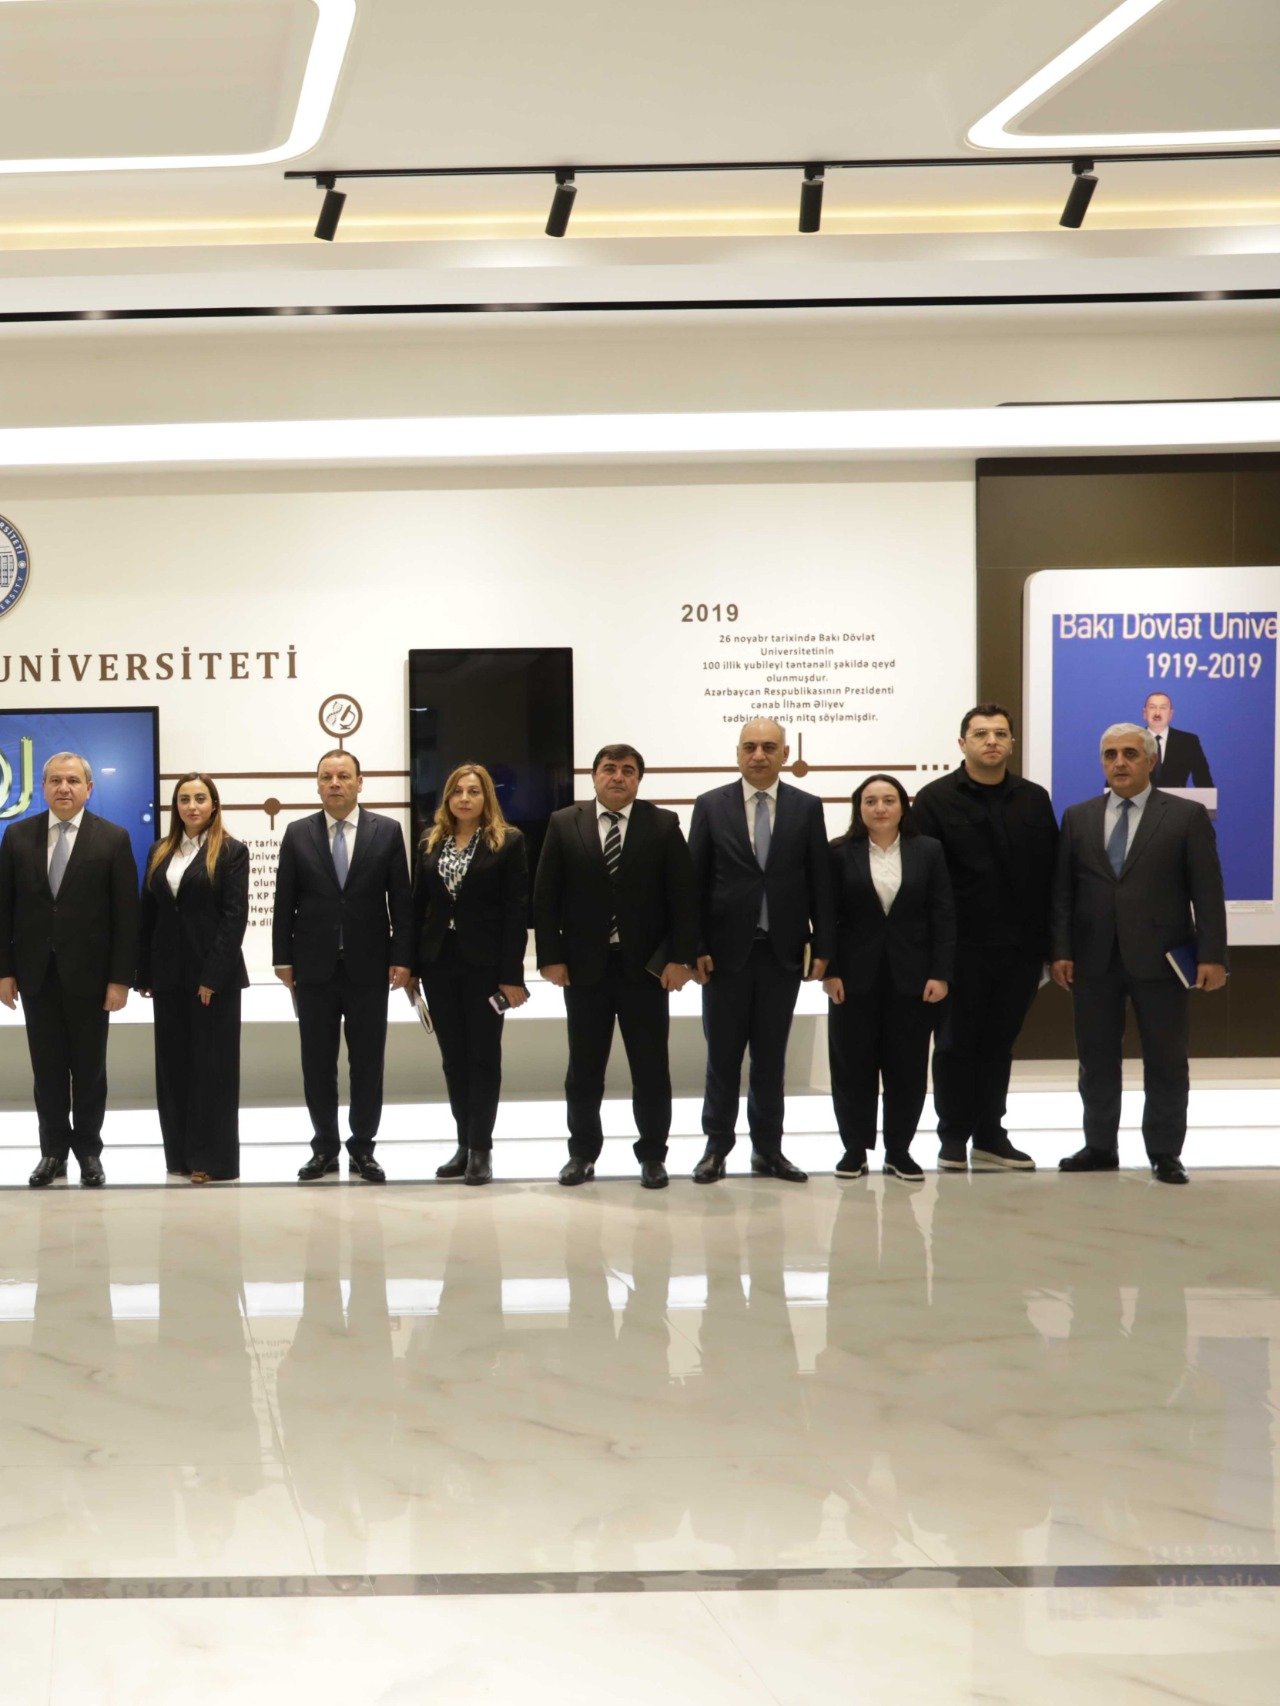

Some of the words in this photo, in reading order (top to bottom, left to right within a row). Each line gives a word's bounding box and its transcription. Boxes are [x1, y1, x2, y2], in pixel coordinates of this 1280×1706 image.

[681, 603, 738, 622] 2019
[1059, 612, 1114, 640] Bakı
[1122, 612, 1203, 640] Dövlət
[720, 635, 731, 643] 26
[734, 634, 768, 644] noyabr
[771, 634, 816, 642] tarixində
[819, 633, 839, 641] Bakı
[843, 633, 875, 641] Dövlət
[761, 647, 834, 656] Universitetinin
[703, 662, 720, 670] 100
[723, 661, 741, 669] illik
[744, 661, 783, 670] yubileyi
[872, 659, 895, 669] qeyd
[1146, 652, 1263, 679] 1919-2019
[767, 674, 828, 683] olunmuşdur.
[704, 688, 761, 697] Azərbaycan
[845, 686, 894, 694] Prezidenti
[813, 700, 844, 710] Əliyev
[796, 714, 815, 723] nitq
